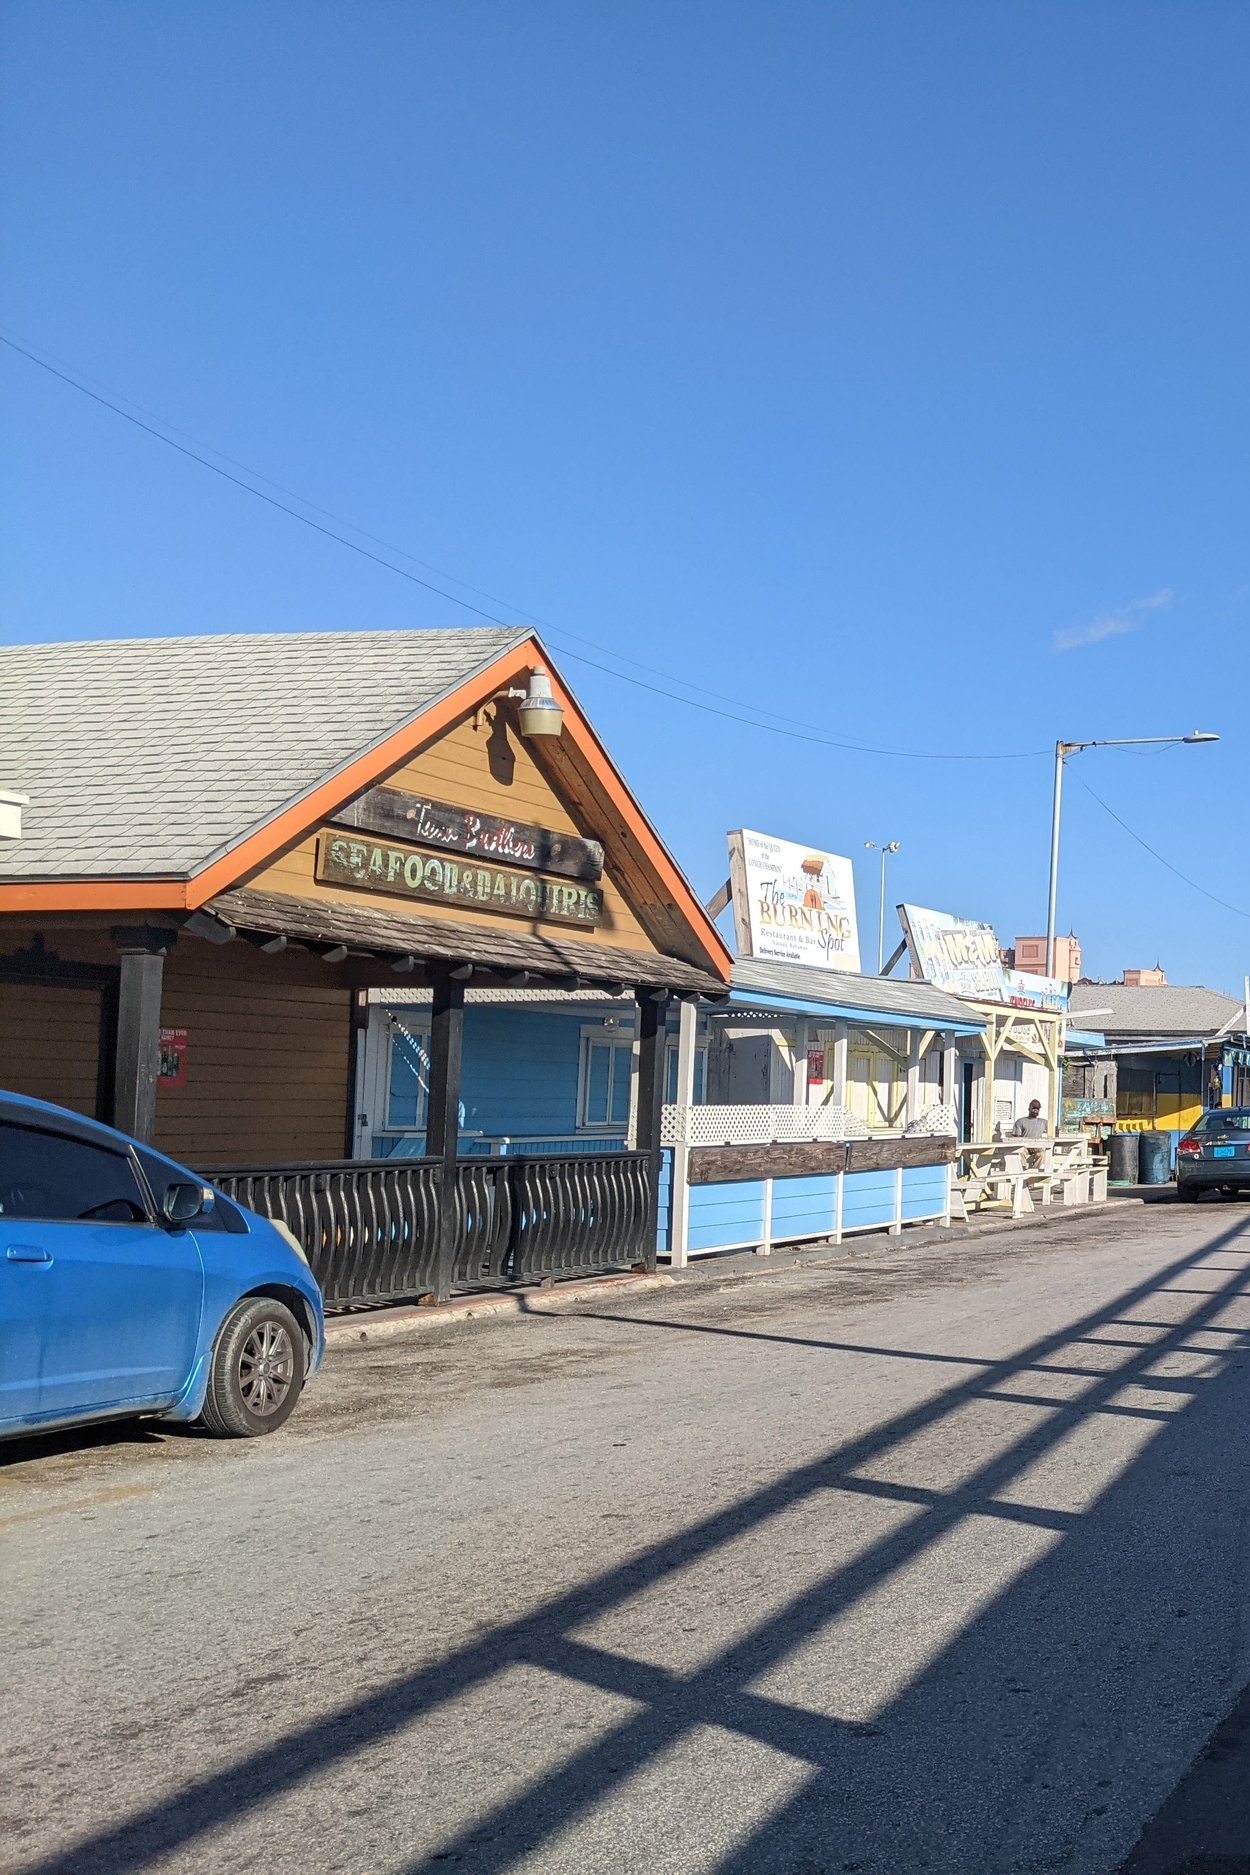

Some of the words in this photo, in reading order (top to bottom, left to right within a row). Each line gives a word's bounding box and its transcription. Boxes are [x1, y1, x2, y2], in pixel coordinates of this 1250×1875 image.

[760, 878, 785, 906] The
[758, 899, 852, 939] BURNING
[760, 927, 797, 942] Restaurant
[799, 934, 804, 944] &
[806, 936, 816, 946] Bar
[817, 927, 845, 961] Spot
